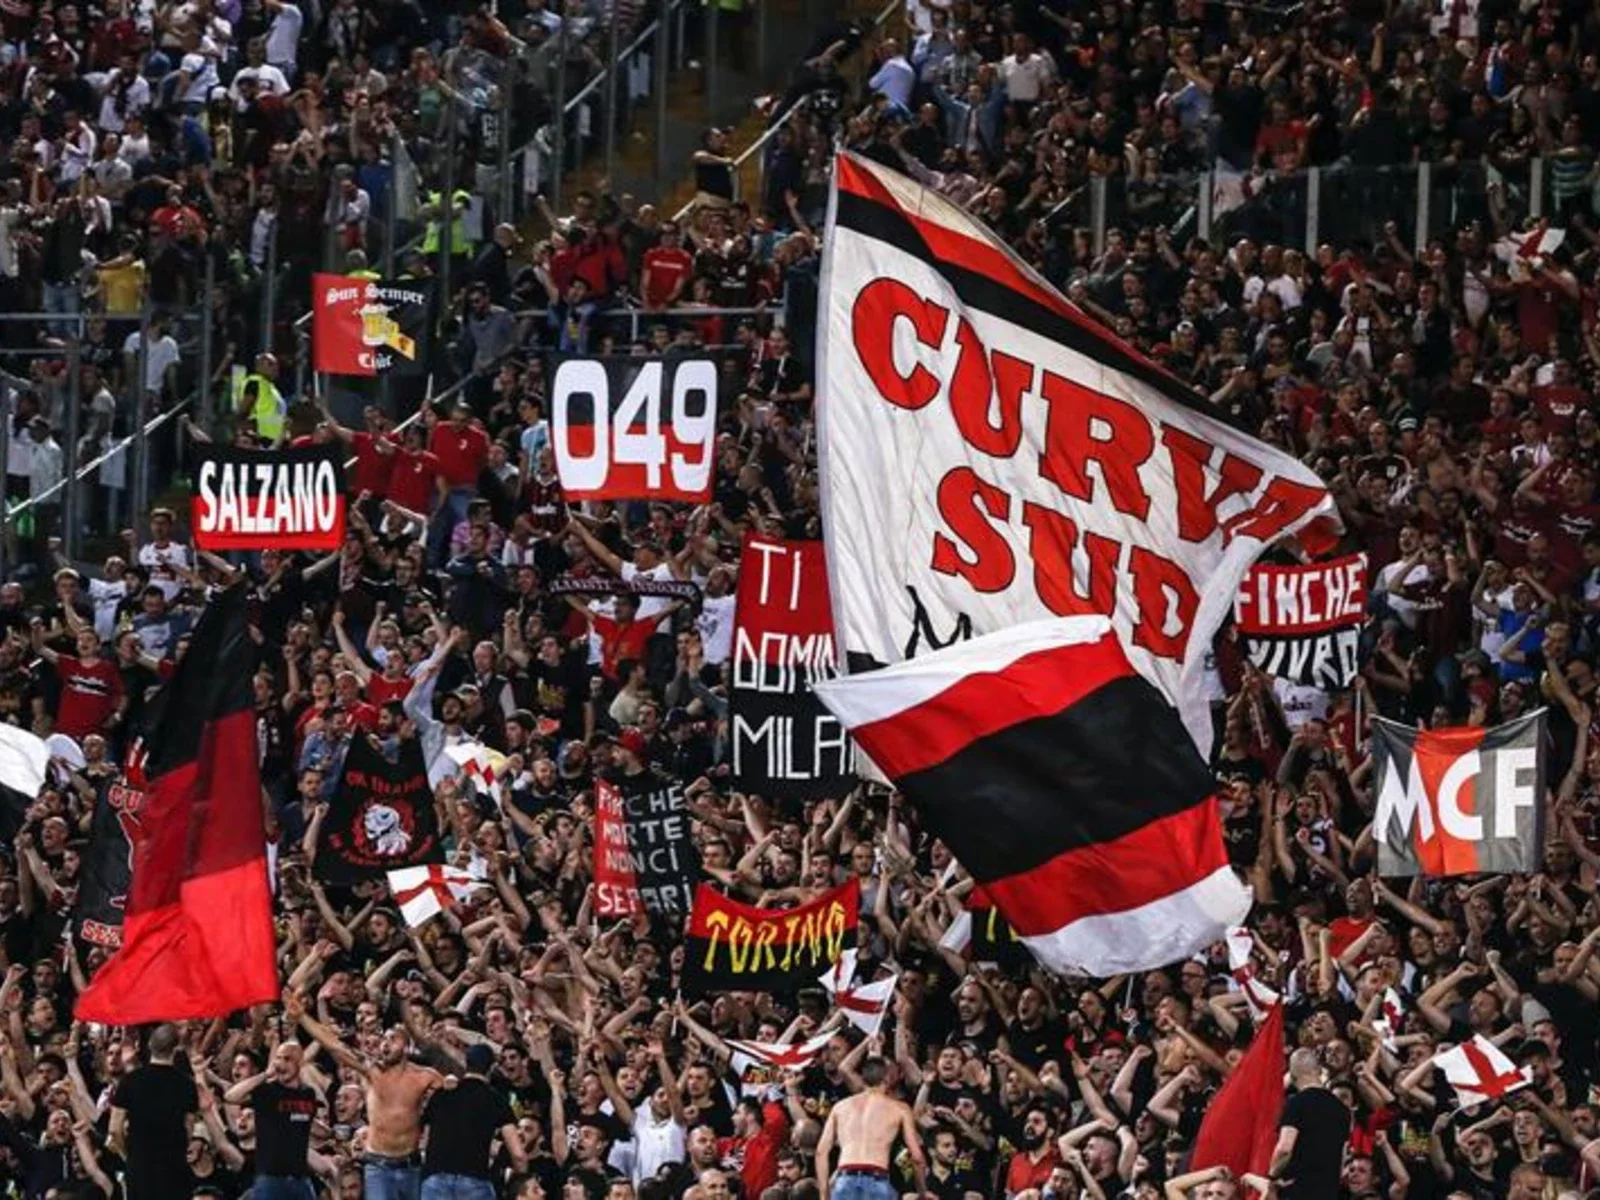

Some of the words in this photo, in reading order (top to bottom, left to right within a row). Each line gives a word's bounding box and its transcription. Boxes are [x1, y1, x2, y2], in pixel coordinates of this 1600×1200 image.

[552, 359, 717, 492] 049
[851, 276, 1330, 549] CURVA
[198, 459, 337, 533] SALZANO
[749, 541, 801, 611] TI
[930, 466, 1202, 664] SUD
[733, 626, 842, 694] DOMIN
[1371, 748, 1537, 845] MCF
[703, 900, 846, 974] TORINO
